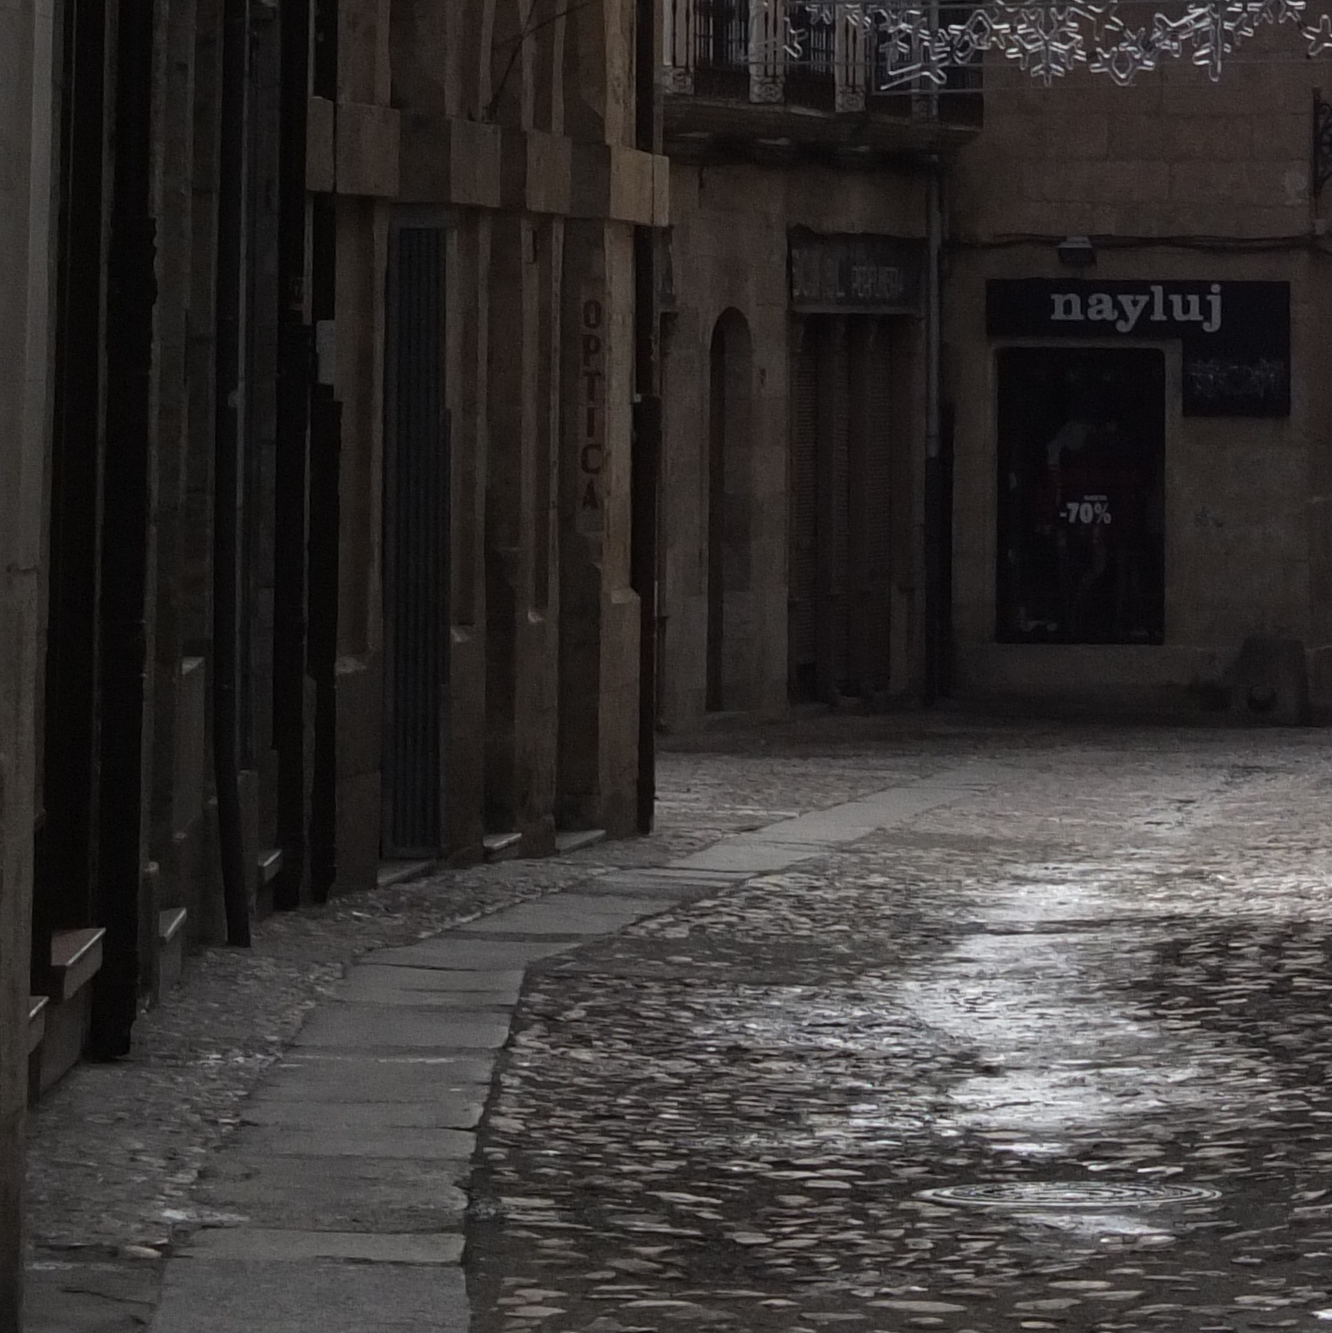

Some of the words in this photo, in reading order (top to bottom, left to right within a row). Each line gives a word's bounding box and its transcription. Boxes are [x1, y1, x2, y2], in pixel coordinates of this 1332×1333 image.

[1050, 283, 1223, 334] nayluj
[581, 299, 603, 510] OPTICA
[1059, 502, 1112, 525] -70%
